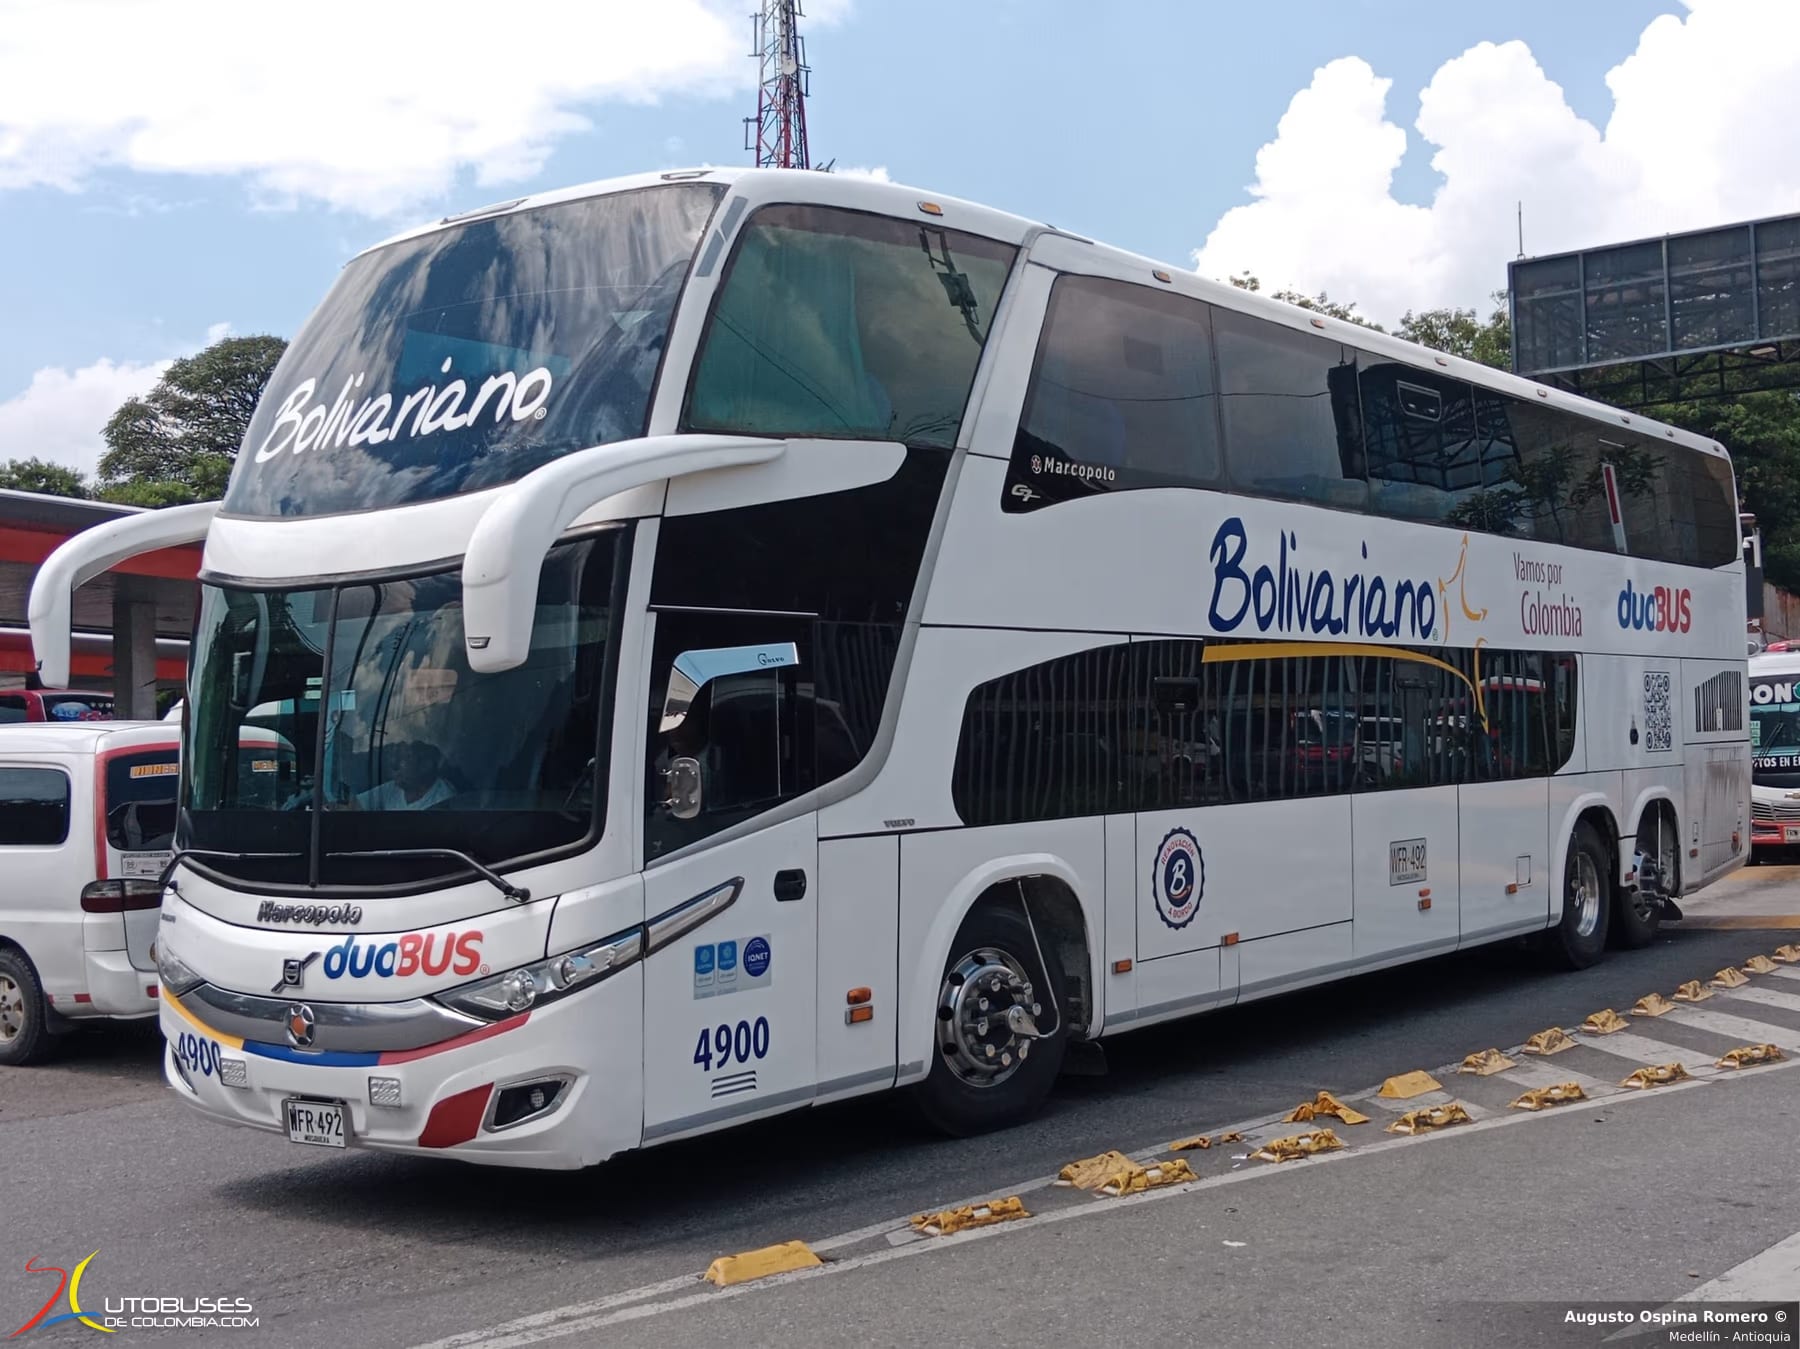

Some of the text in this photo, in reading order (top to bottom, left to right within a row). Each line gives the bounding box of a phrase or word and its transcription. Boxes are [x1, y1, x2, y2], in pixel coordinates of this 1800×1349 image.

[255, 356, 553, 464] Bolivariano
[1044, 456, 1116, 481] Marcopolo
[1208, 517, 1436, 640] Bolivariano
[1513, 552, 1563, 591] Vamos por
[1521, 590, 1583, 637] Colombia
[1618, 579, 1691, 634] duoBUS
[1749, 683, 1792, 704] ON
[257, 900, 362, 926] Marcopolo
[323, 930, 483, 979] duoBUS
[179, 1032, 222, 1077] 4900
[693, 1016, 770, 1071] 4900
